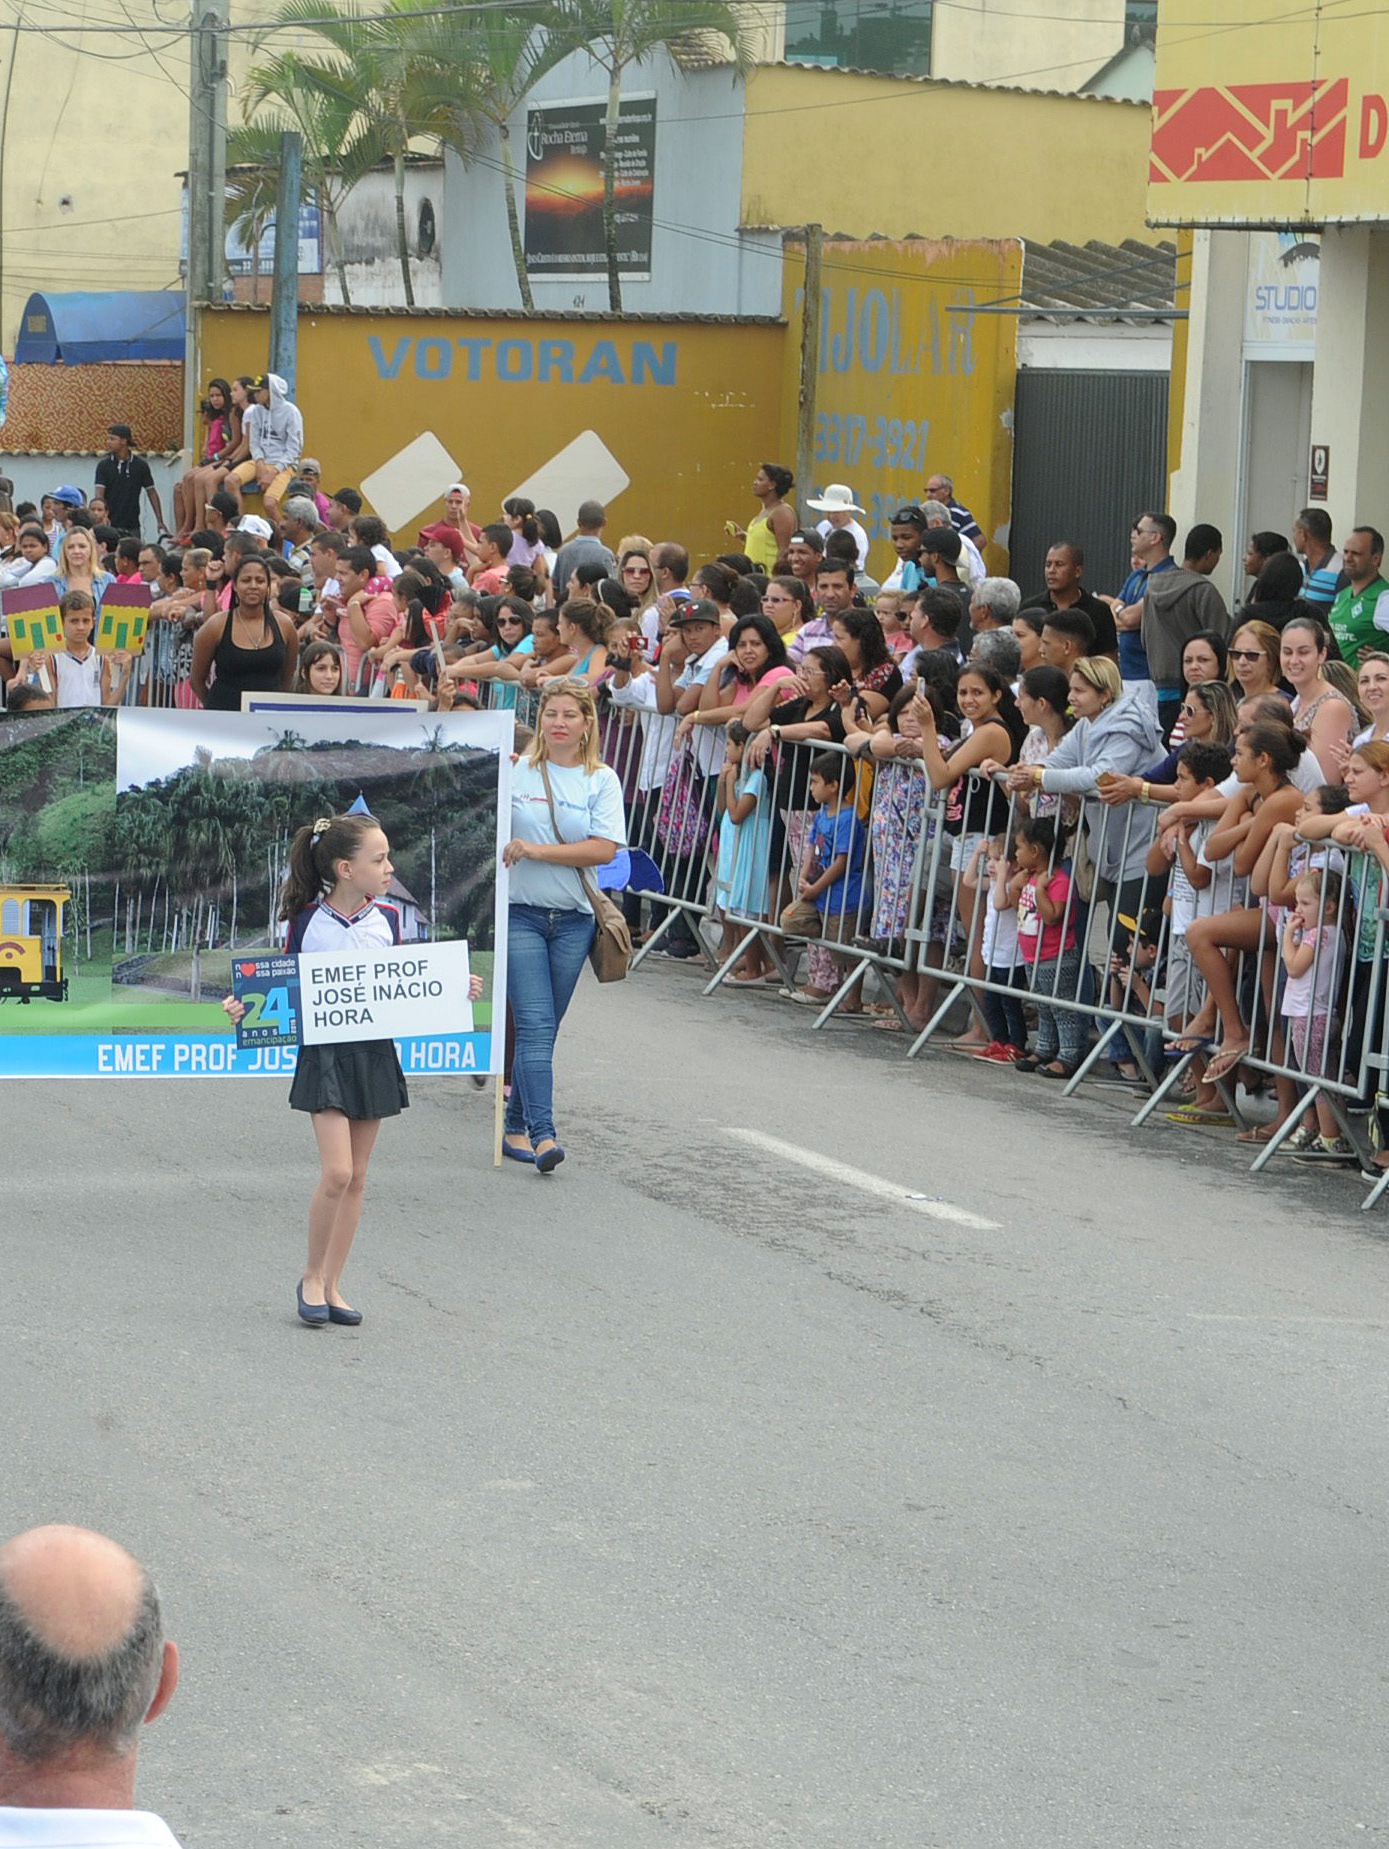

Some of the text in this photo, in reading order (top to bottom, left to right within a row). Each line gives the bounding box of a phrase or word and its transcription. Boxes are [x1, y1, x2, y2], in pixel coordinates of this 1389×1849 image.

[1255, 286, 1317, 310] STUDIO
[368, 335, 678, 387] VOTORAN
[814, 411, 930, 473] 3317-3921
[271, 958, 297, 969] cidade
[271, 967, 297, 979] paixão
[311, 960, 429, 985] EMEF PROF
[312, 978, 443, 1006] JOSÉ INÁCIO
[241, 986, 297, 1035] 24
[314, 1008, 374, 1028] HORA
[242, 1028, 278, 1038] anos
[242, 1034, 298, 1046] emancipação
[98, 1043, 164, 1072] EMEF
[174, 1042, 238, 1071] PROF
[410, 1041, 476, 1070] HORA
